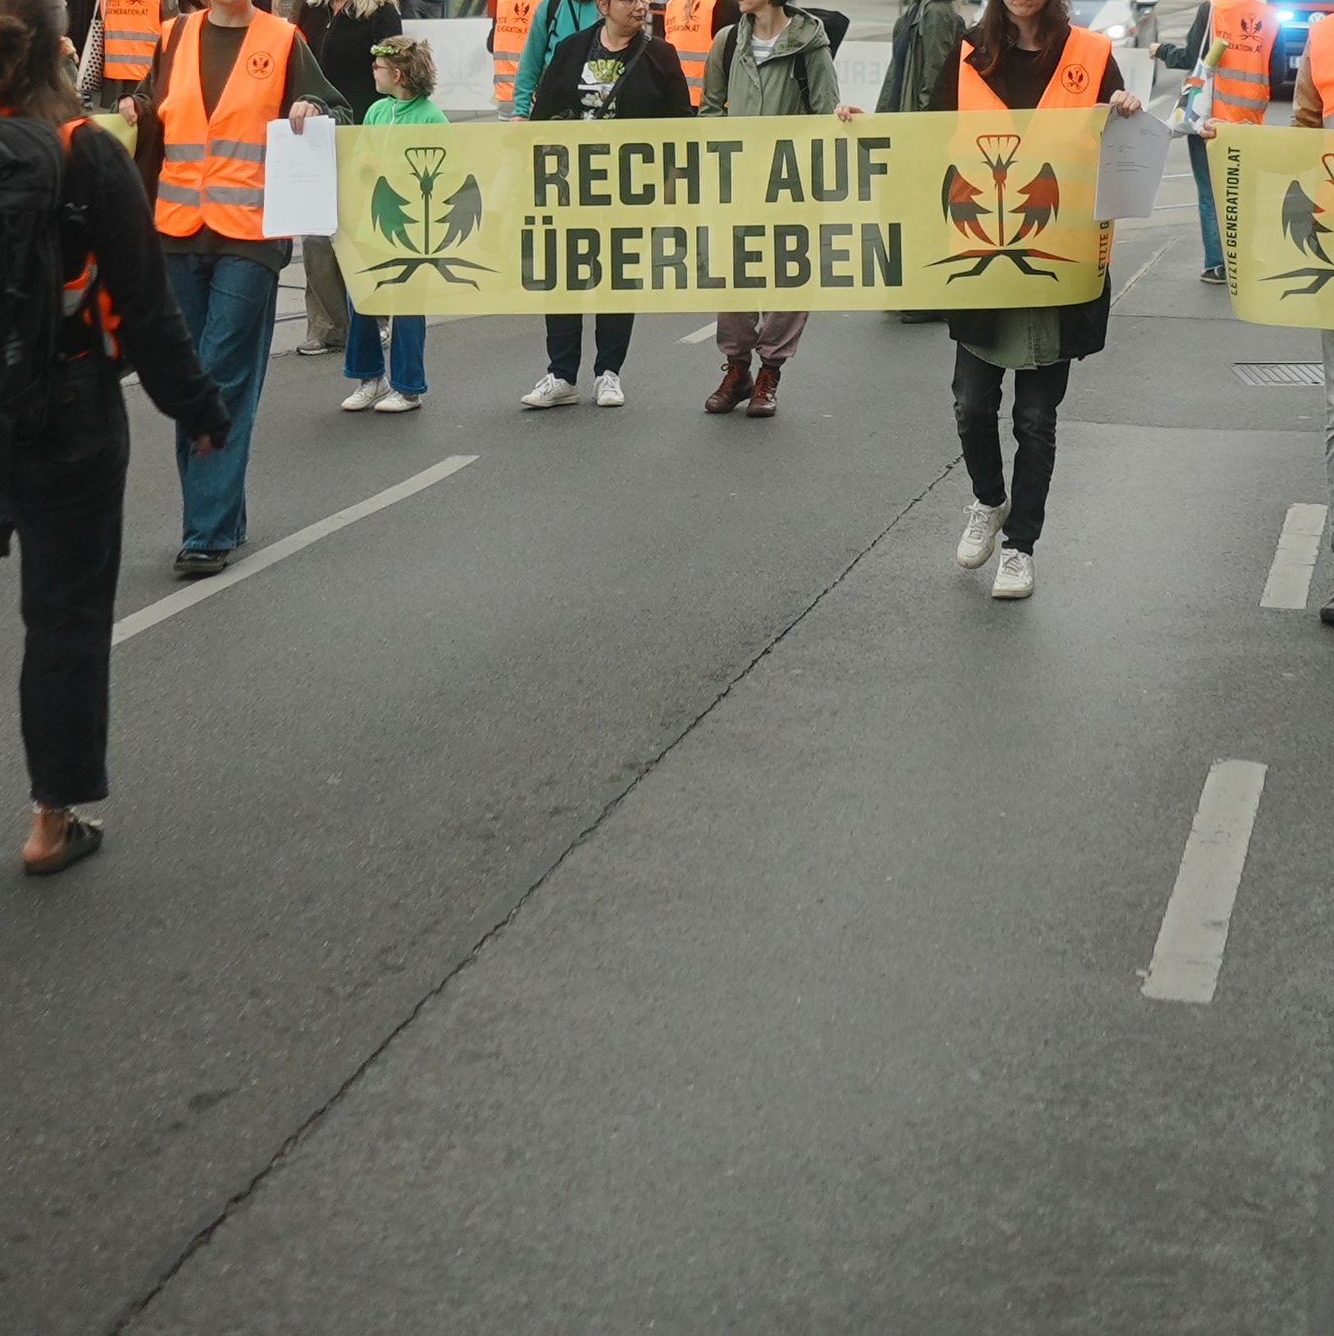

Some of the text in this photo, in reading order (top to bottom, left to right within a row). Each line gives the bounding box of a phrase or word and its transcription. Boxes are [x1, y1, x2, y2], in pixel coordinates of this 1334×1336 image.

[533, 137, 891, 207] RECHT AUF
[521, 215, 903, 292] ÜBERLEBEN
[1098, 233, 1109, 278] LETZTE
[1226, 146, 1241, 296] LETZTE GENERATION.AT
